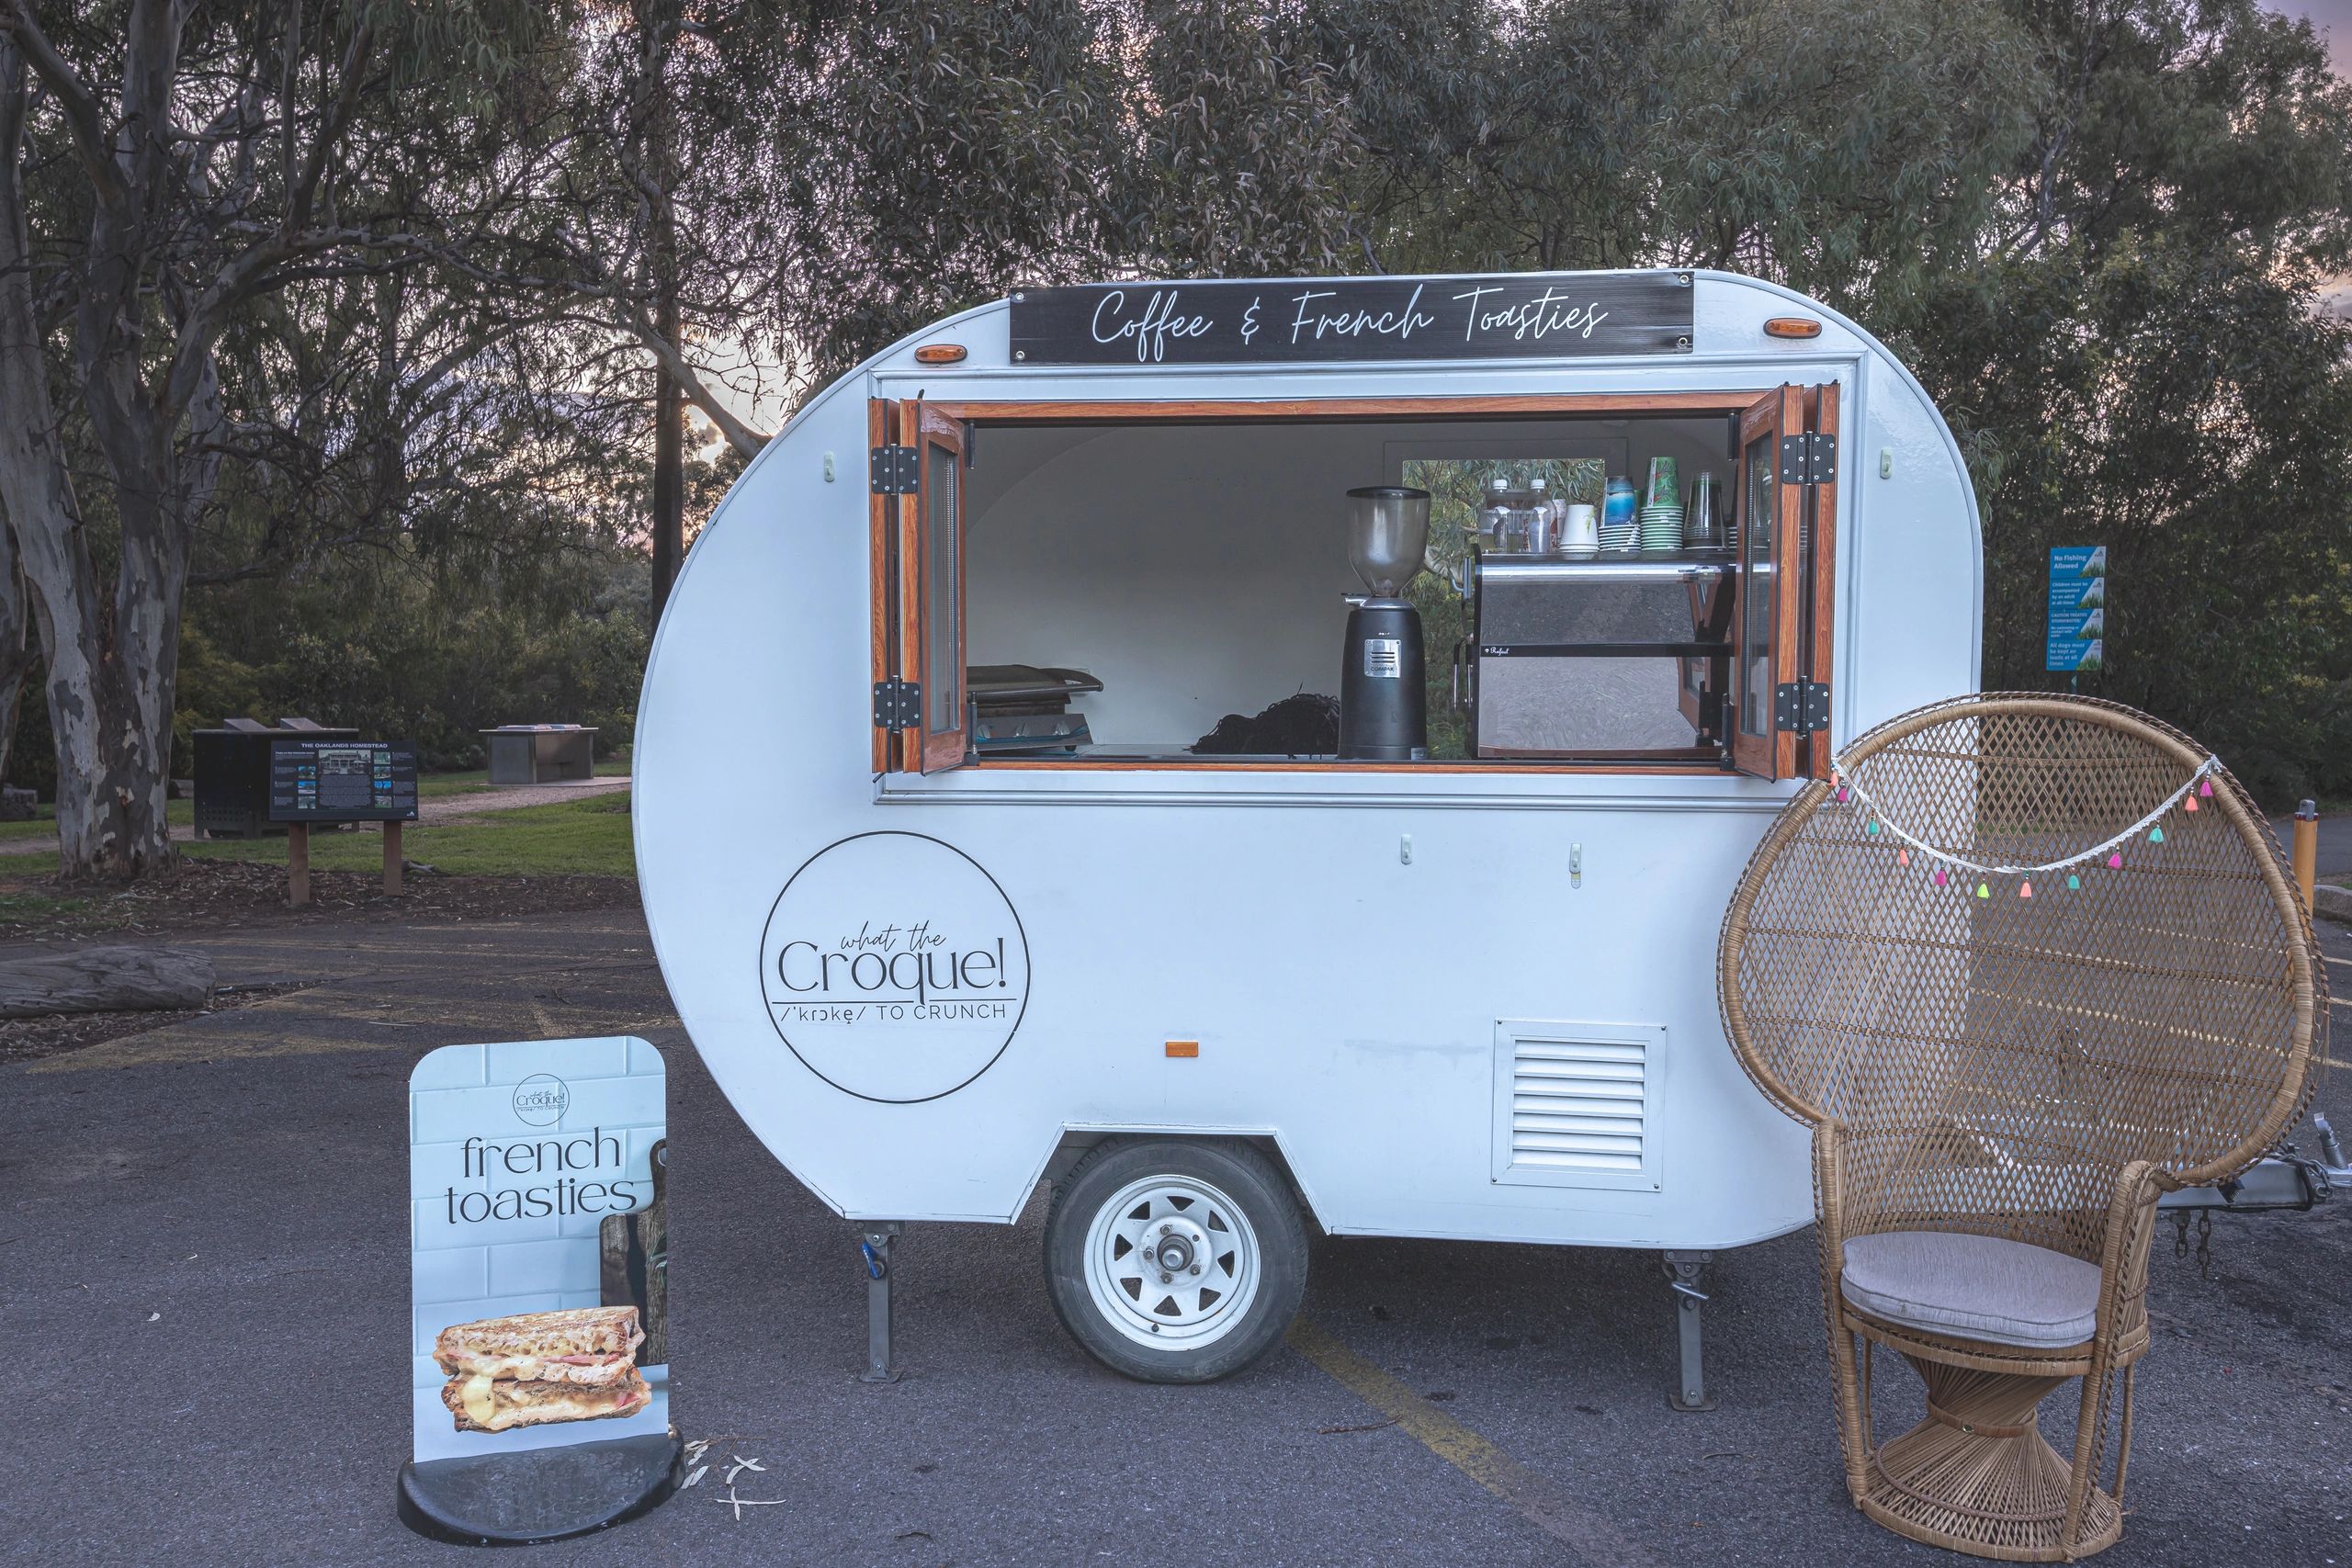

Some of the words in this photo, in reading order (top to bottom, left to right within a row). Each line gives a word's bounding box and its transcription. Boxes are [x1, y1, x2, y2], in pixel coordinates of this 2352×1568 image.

[1092, 290, 1214, 363] Coffee
[1241, 297, 1261, 345] &
[1291, 283, 1434, 344] French
[1453, 287, 1609, 343] Toasties
[841, 920, 902, 953] what
[908, 919, 946, 952] the
[778, 937, 1007, 1006] Croque!
[876, 1005, 904, 1021] TO
[913, 1003, 1006, 1021] CRUNCH
[516, 1092, 565, 1107] Croque!
[460, 1126, 621, 1179] french
[444, 1178, 638, 1225] toasties
